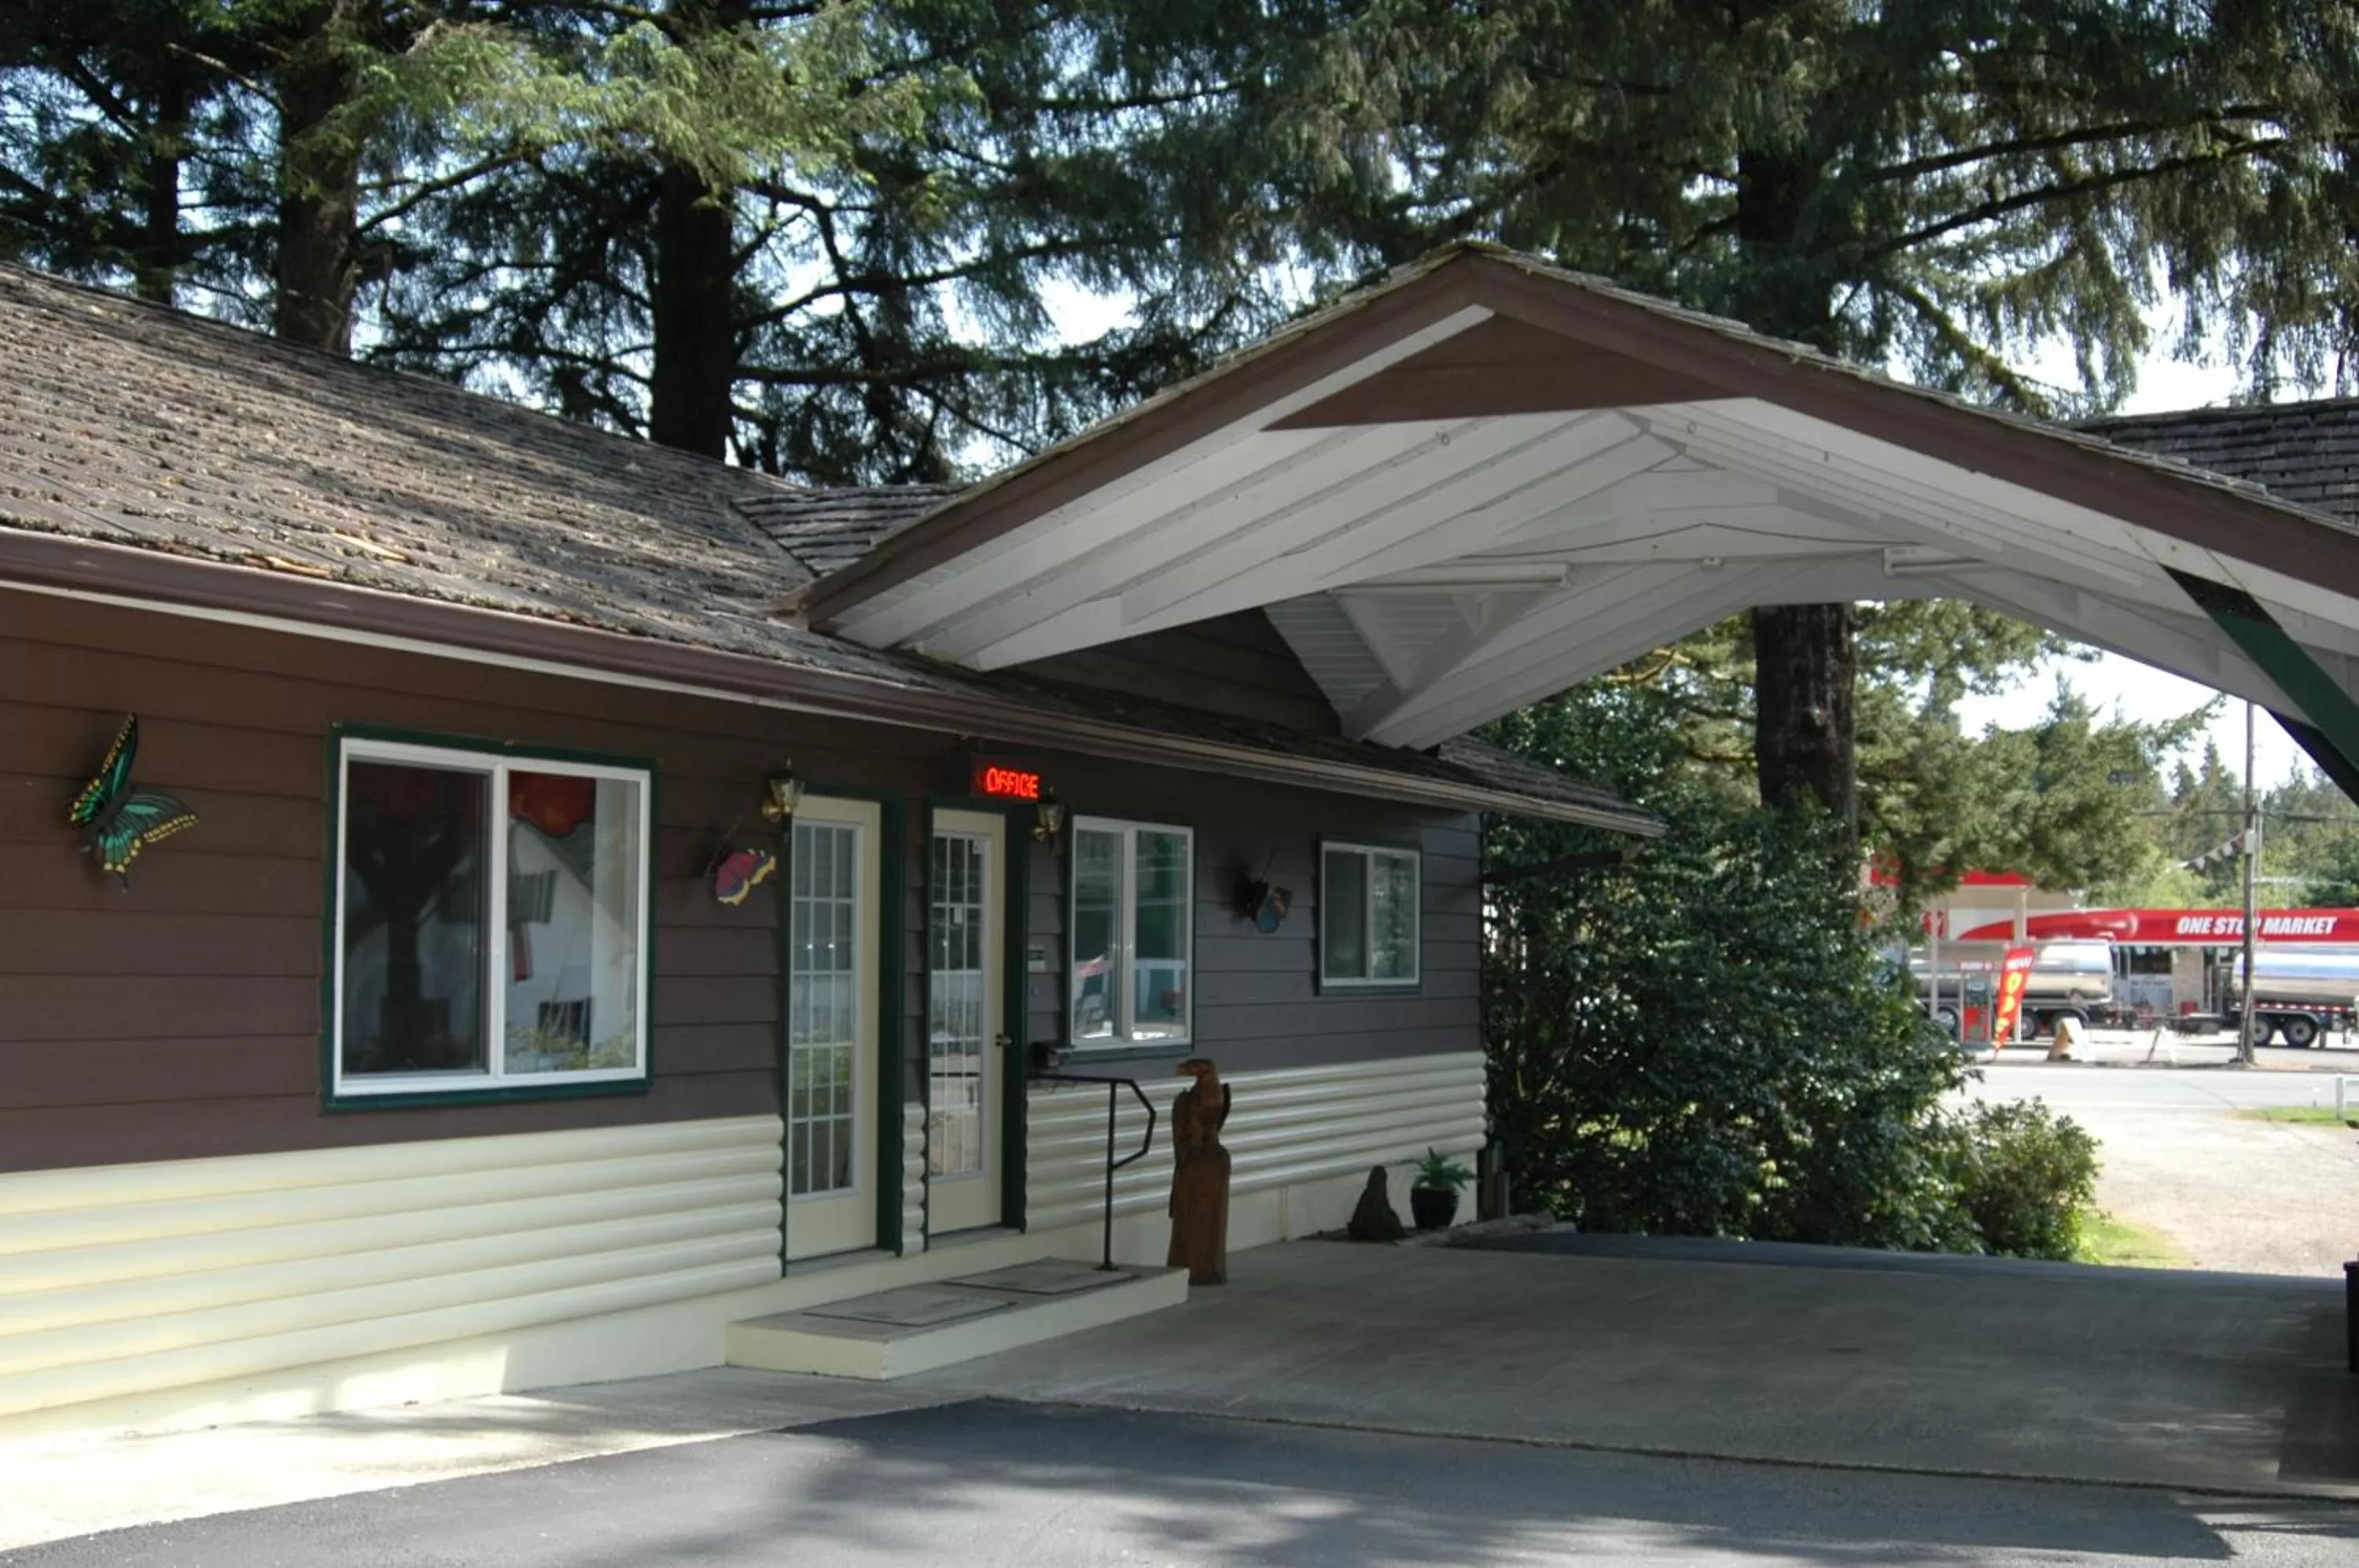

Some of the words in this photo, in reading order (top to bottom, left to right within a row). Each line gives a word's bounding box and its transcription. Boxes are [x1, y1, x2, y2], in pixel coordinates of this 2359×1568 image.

[986, 767, 1039, 799] OFFICE
[2177, 916, 2213, 935] ONE
[2261, 917, 2338, 935] MARKET
